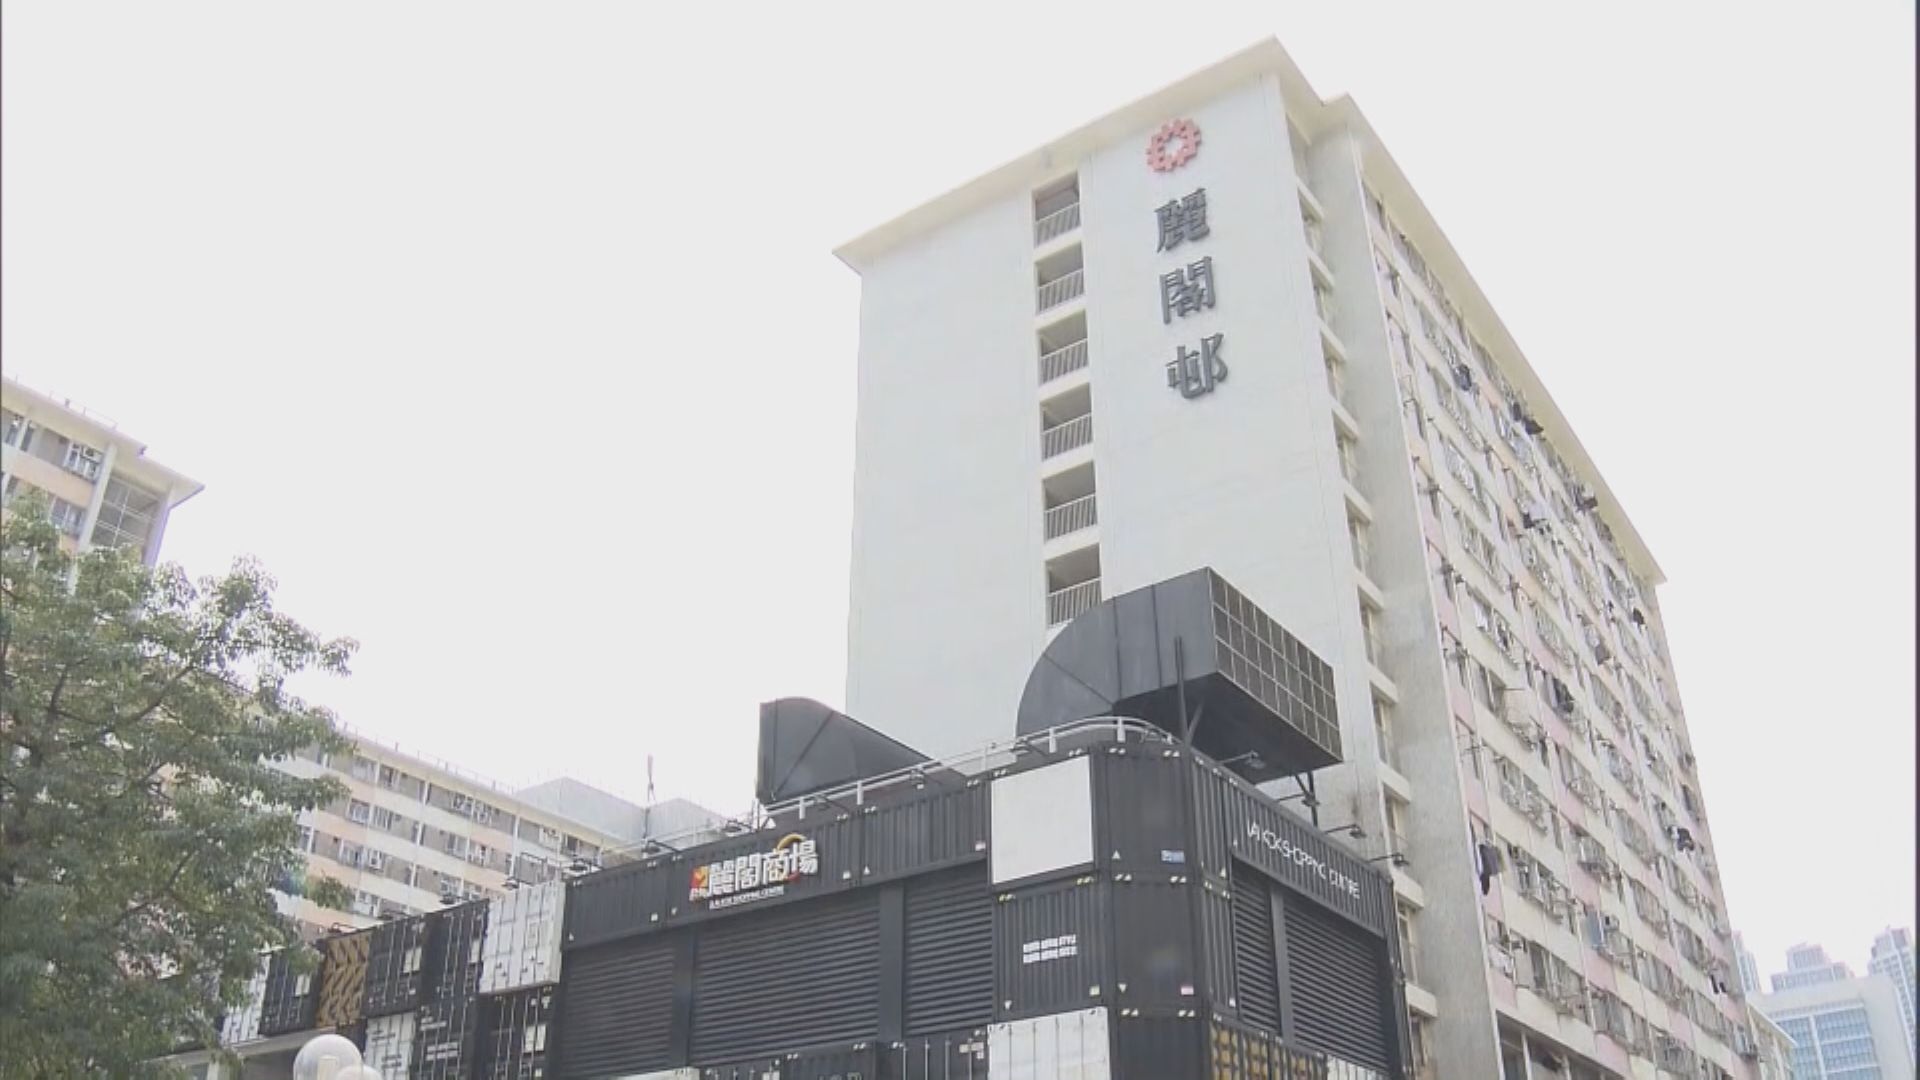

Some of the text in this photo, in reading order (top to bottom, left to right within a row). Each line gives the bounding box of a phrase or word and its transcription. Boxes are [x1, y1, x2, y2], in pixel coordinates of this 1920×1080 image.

[1154, 187, 1229, 400] 麗閣邨
[708, 839, 819, 898] 麗閣商場
